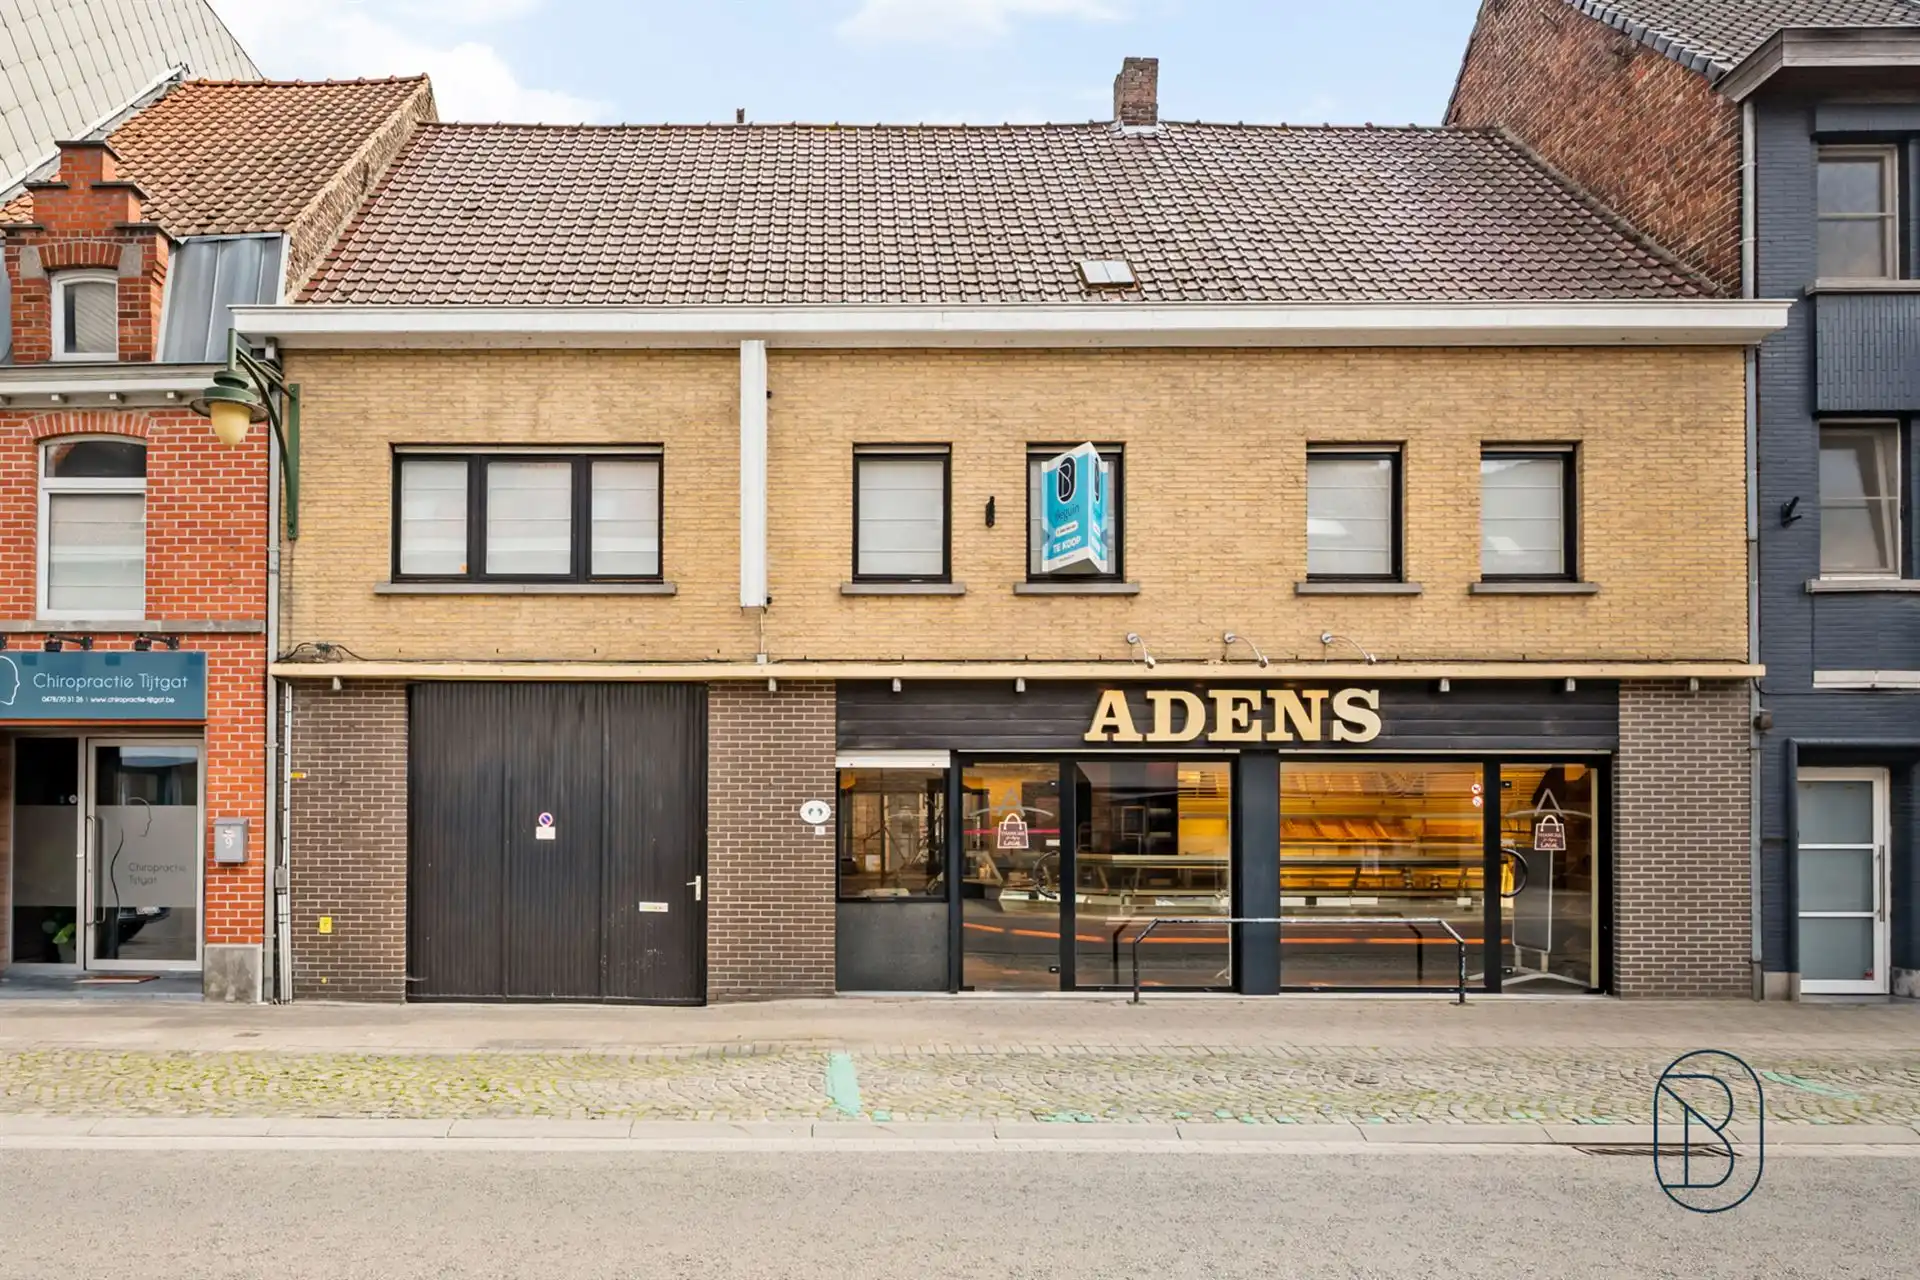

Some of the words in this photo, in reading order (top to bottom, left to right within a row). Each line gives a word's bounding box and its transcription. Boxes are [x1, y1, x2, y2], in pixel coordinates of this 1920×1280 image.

[1053, 543, 1062, 554] TE
[1062, 535, 1081, 551] KOOP
[33, 672, 134, 692] Chiropractie
[138, 673, 189, 692] Tijtgat
[1084, 688, 1382, 743] ADENS
